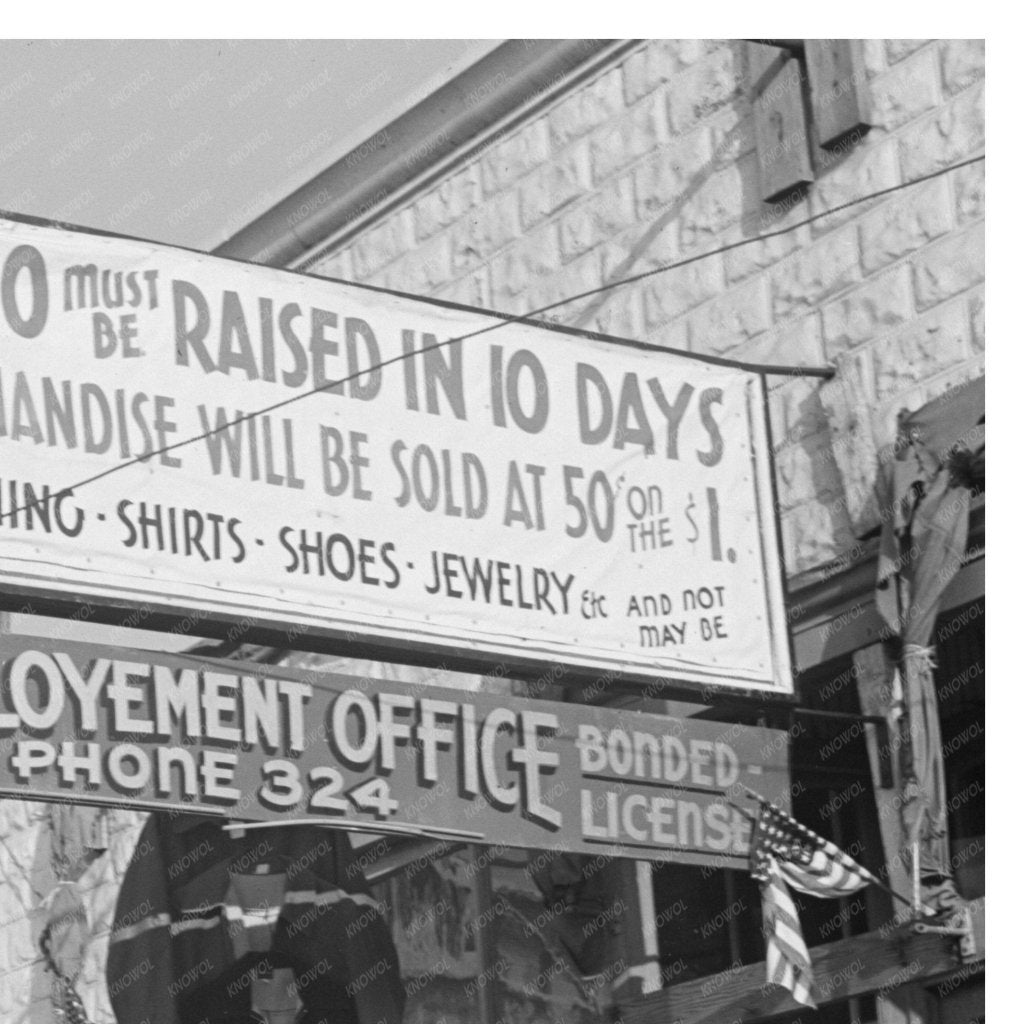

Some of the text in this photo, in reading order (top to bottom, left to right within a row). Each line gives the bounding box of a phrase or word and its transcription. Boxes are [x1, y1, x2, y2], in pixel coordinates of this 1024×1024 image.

[63, 263, 159, 311] MUST
[92, 312, 145, 359] BE
[172, 279, 381, 402] RAISED
[401, 329, 467, 421] IN
[489, 344, 550, 434] 10
[576, 362, 725, 467] DAYS
[197, 403, 305, 490] WILL
[319, 423, 373, 501] BE
[391, 438, 489, 520] SOLD
[502, 459, 547, 531] AT
[626, 517, 673, 553] THE
[117, 499, 246, 563] SHIRTS
[278, 526, 401, 589] SHOES
[425, 550, 575, 616] JEWELRY
[638, 615, 728, 648] MAY BE
[12, 741, 400, 815] PHONE 324
[332, 688, 563, 830] OFFICE
